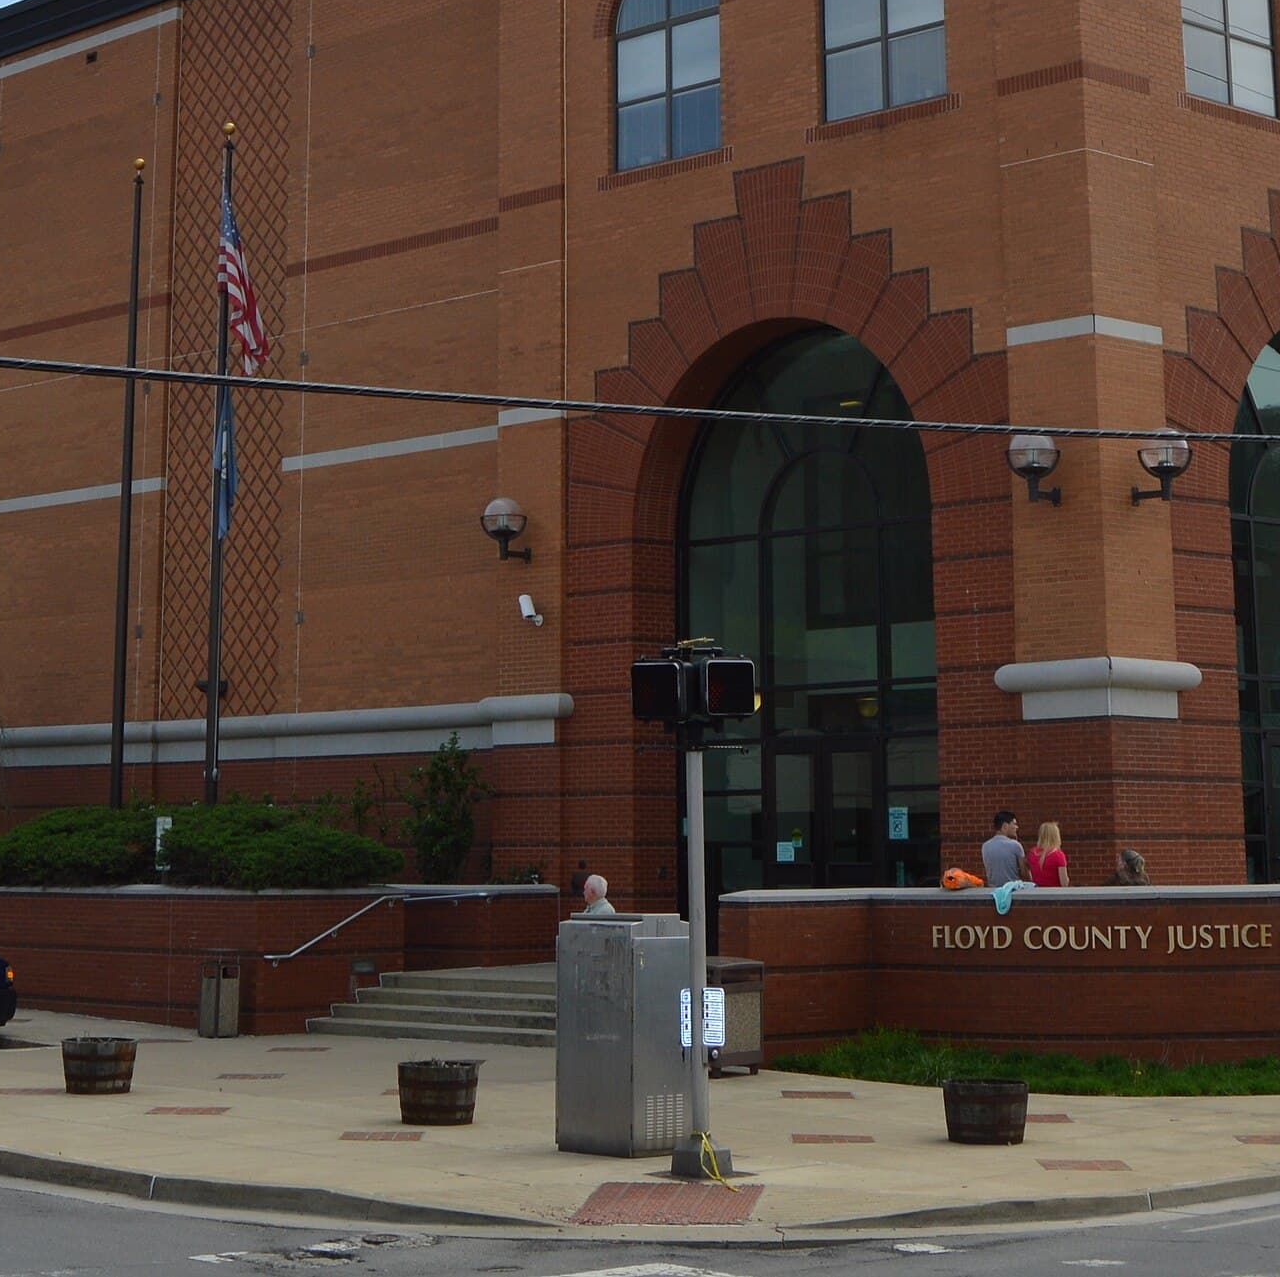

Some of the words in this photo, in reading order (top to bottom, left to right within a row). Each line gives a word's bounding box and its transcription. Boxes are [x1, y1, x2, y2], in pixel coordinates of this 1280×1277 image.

[931, 924, 1013, 949] FLOYD
[1023, 924, 1153, 951] COUNTY
[1167, 923, 1273, 954] JUSTICE
